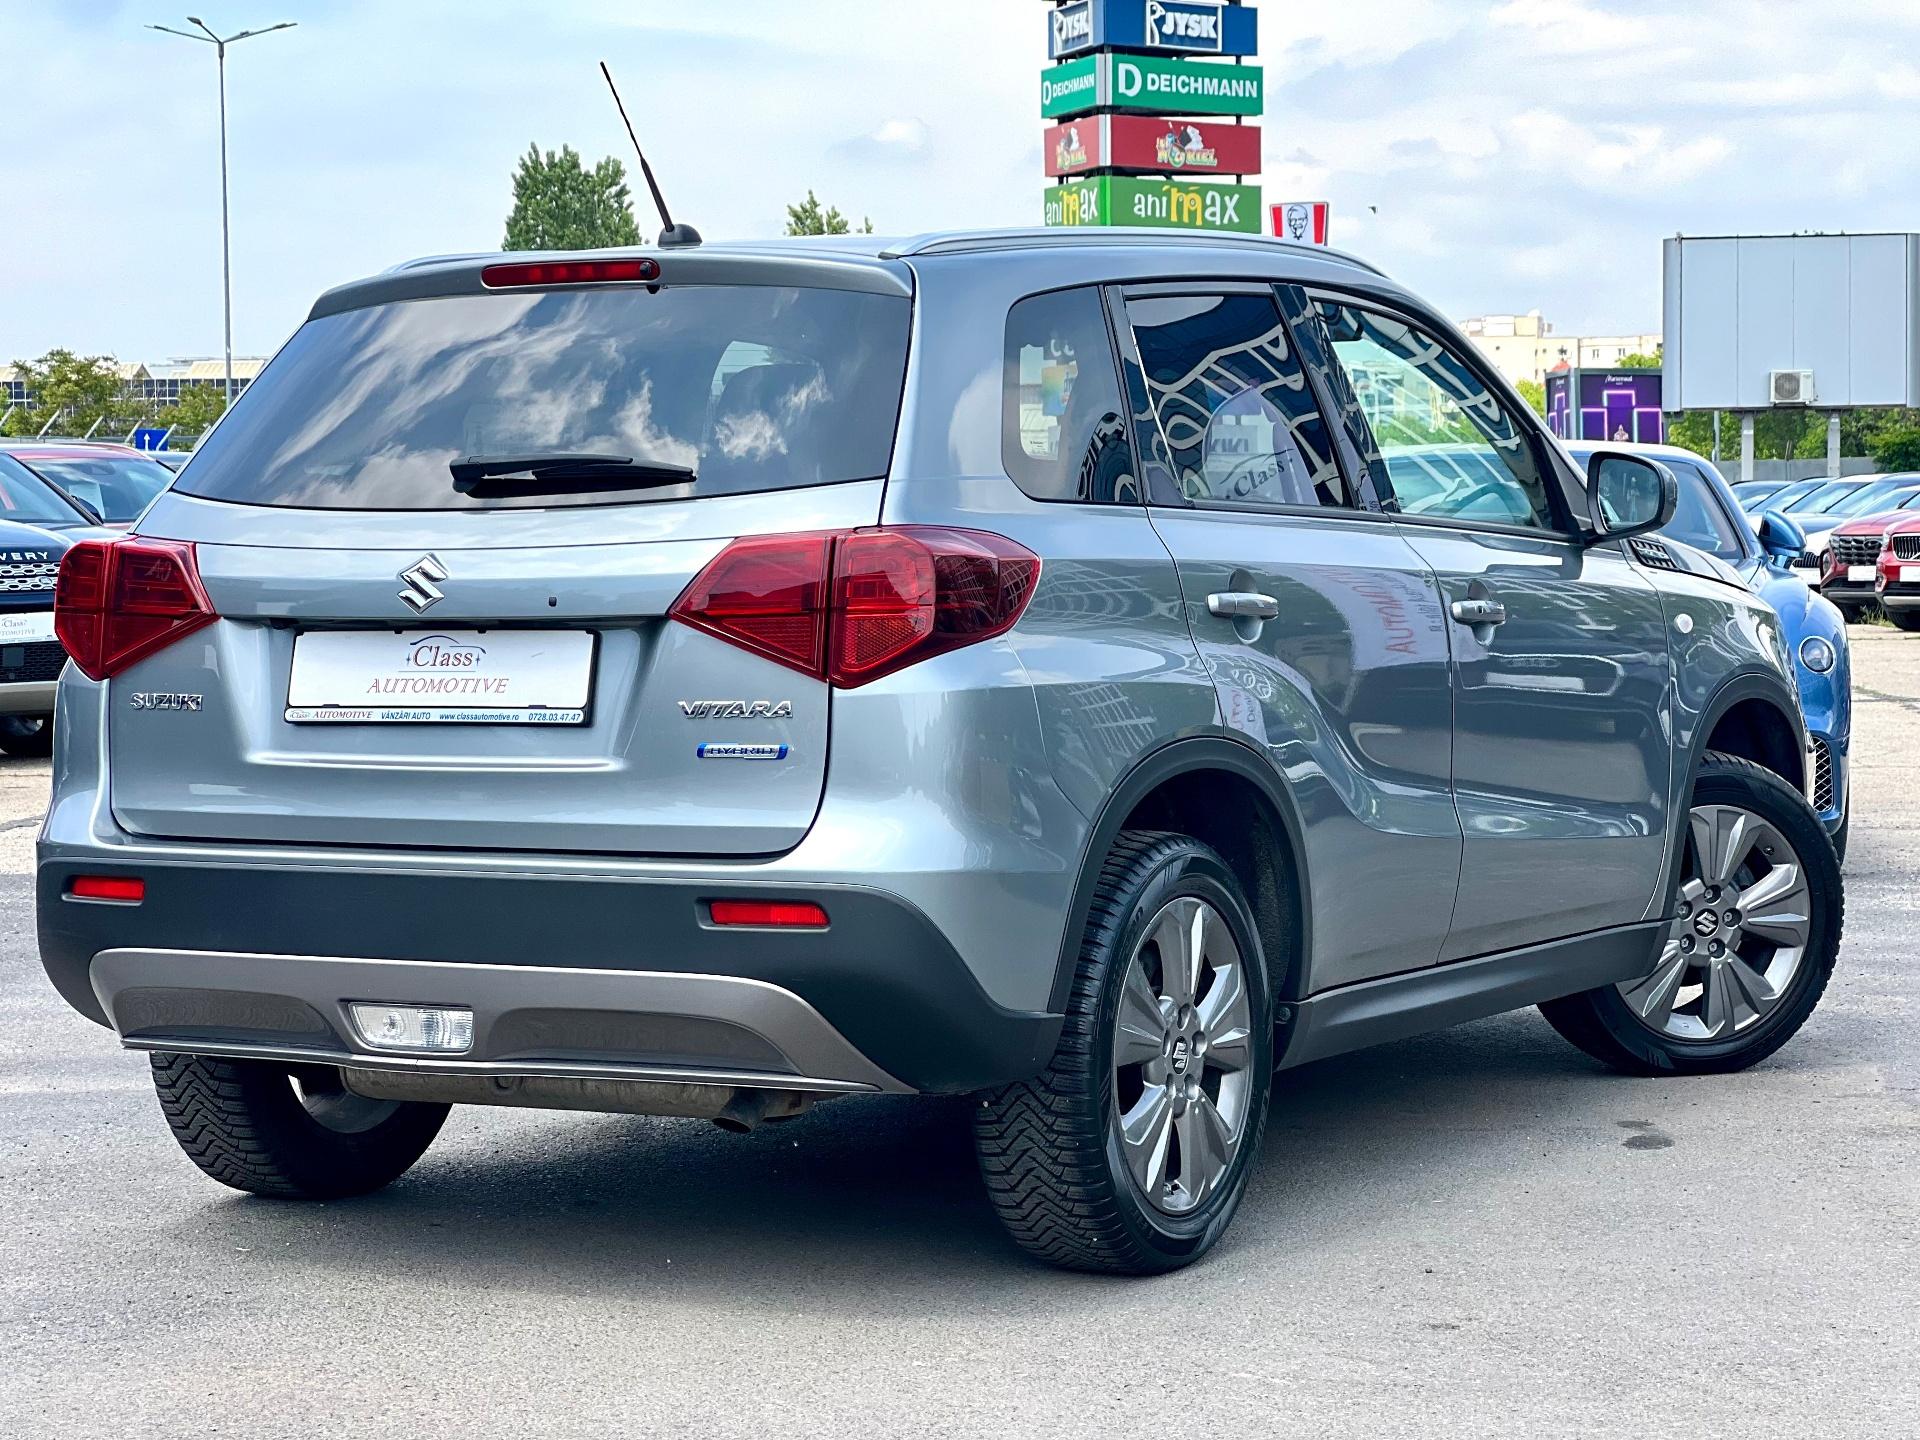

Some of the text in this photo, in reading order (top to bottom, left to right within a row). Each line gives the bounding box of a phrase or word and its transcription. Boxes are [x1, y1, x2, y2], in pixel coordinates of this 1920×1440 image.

[1061, 11, 1089, 41] JYSK
[1161, 11, 1218, 39] JYSK
[1052, 73, 1095, 99] DEICHMANN
[1118, 62, 1259, 98] D DEICHMANN
[1046, 186, 1098, 226] animax
[1133, 184, 1241, 226] animax
[1233, 460, 1285, 497] Class
[413, 645, 474, 667] Class
[366, 677, 510, 694] AUTOMOTIVE
[130, 692, 203, 712] SUZUKI
[677, 700, 794, 719] VITARA
[313, 710, 373, 720] AUTOMOTIVE
[411, 711, 432, 721] AUTO
[439, 712, 520, 721] www.classautomotive.ro
[528, 712, 581, 722] 0728.03.47.47
[705, 745, 778, 757] HYBRID
